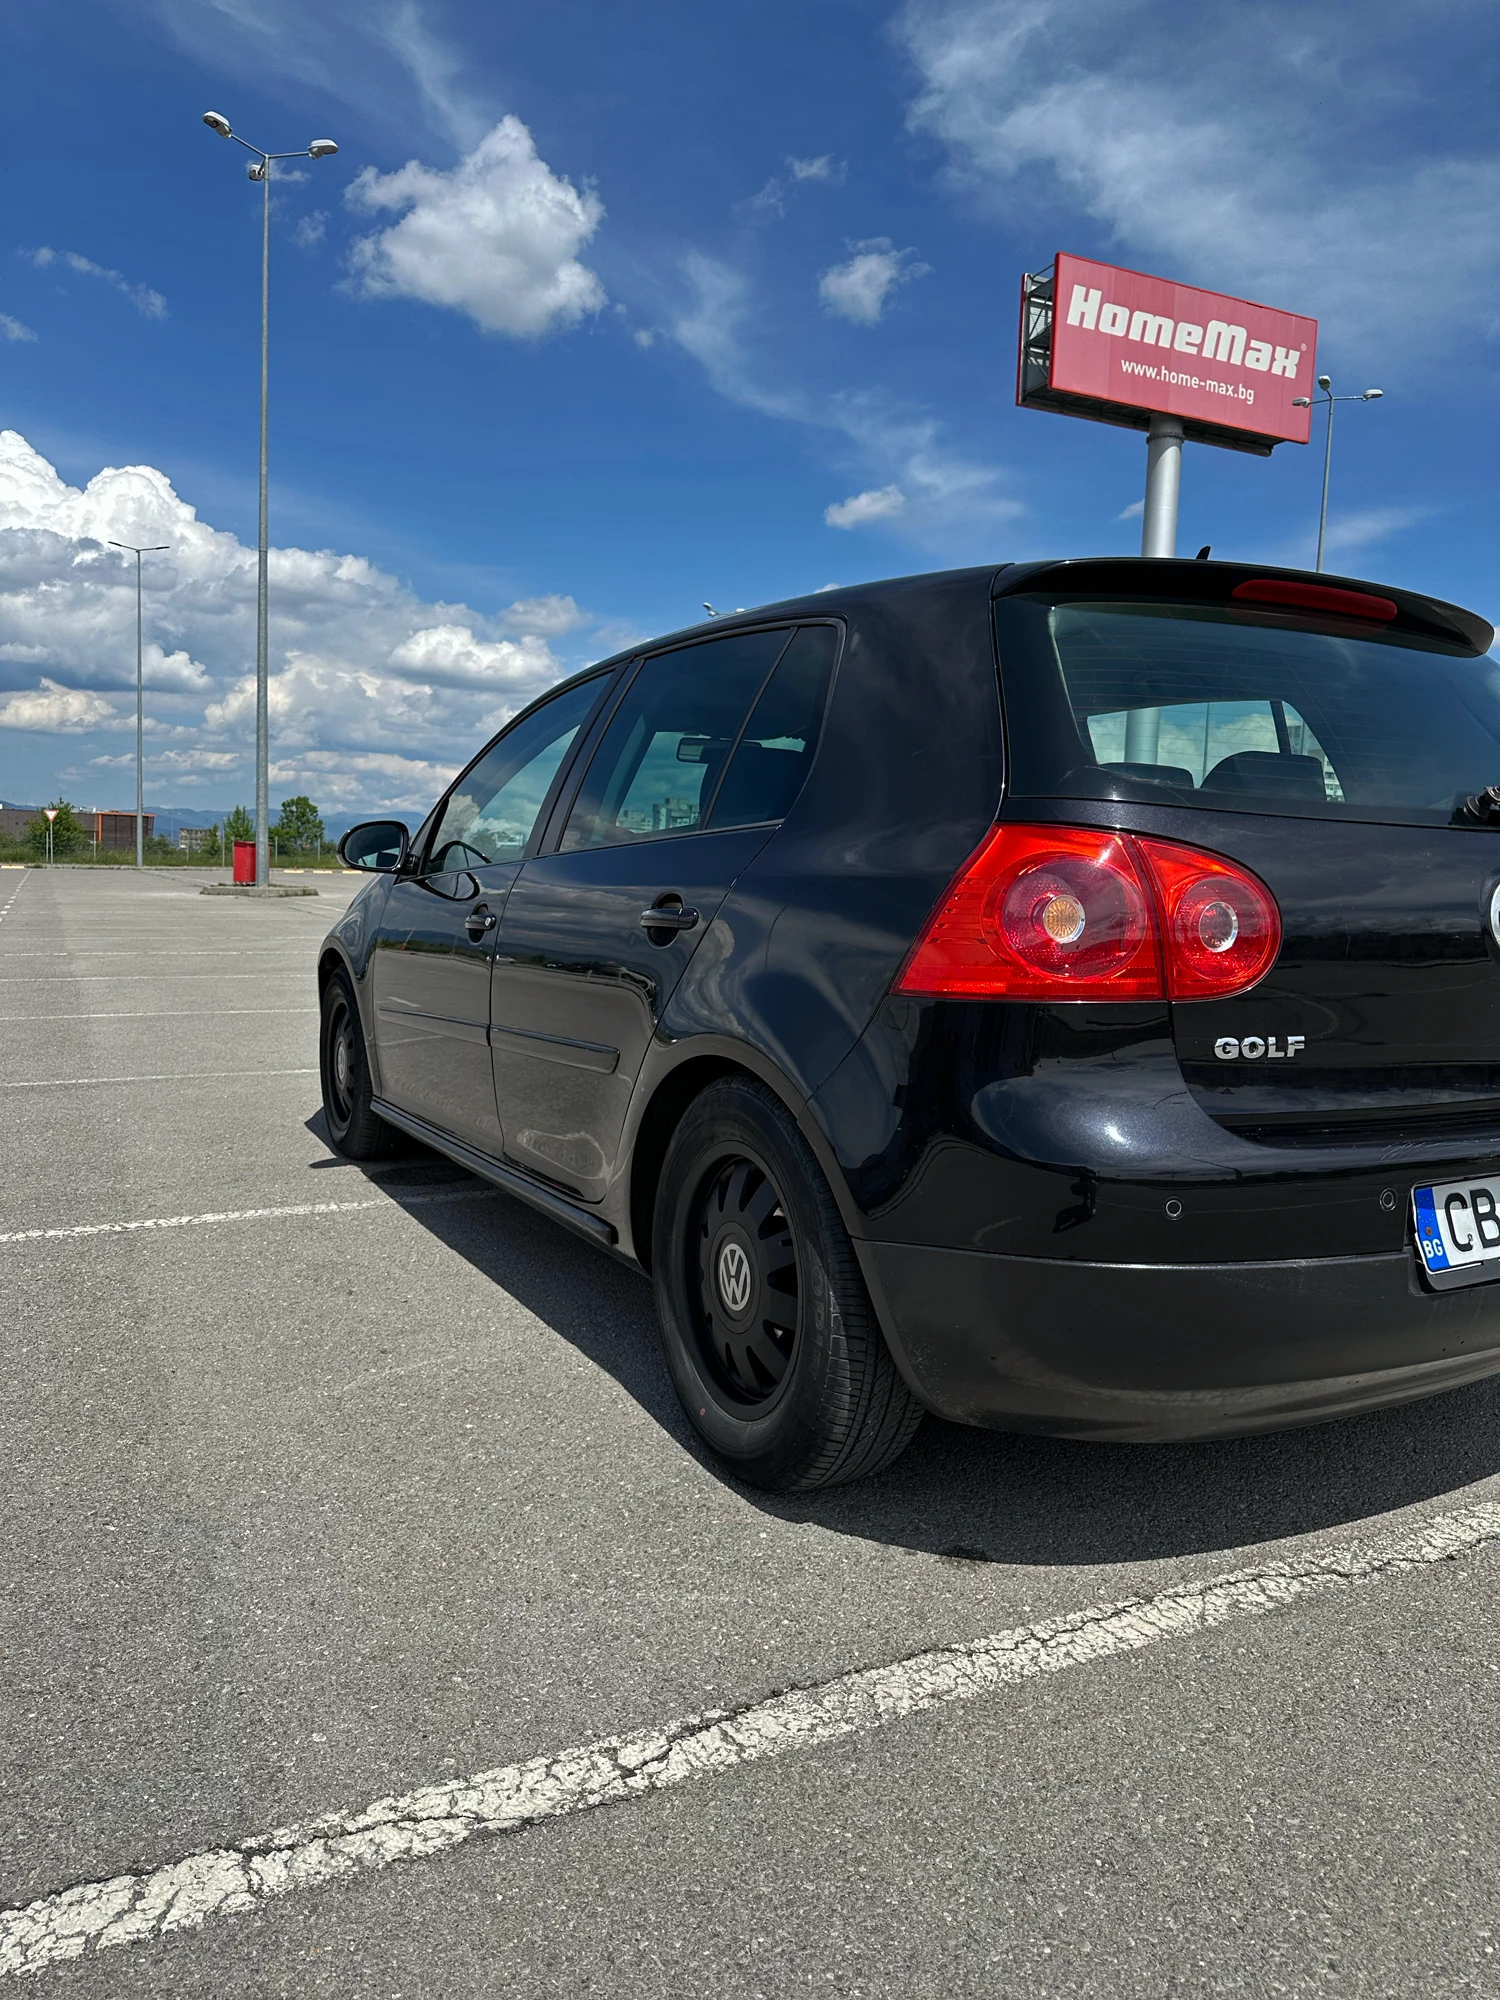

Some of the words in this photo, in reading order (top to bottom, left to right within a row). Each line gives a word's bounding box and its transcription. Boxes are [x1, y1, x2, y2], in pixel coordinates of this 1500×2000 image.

[1067, 284, 1300, 379] HomeMax
[1121, 359, 1254, 405] www.home-max.bg
[1214, 1035, 1305, 1059] GOLF
[1422, 1239, 1443, 1259] BG
[720, 1243, 751, 1311] VW
